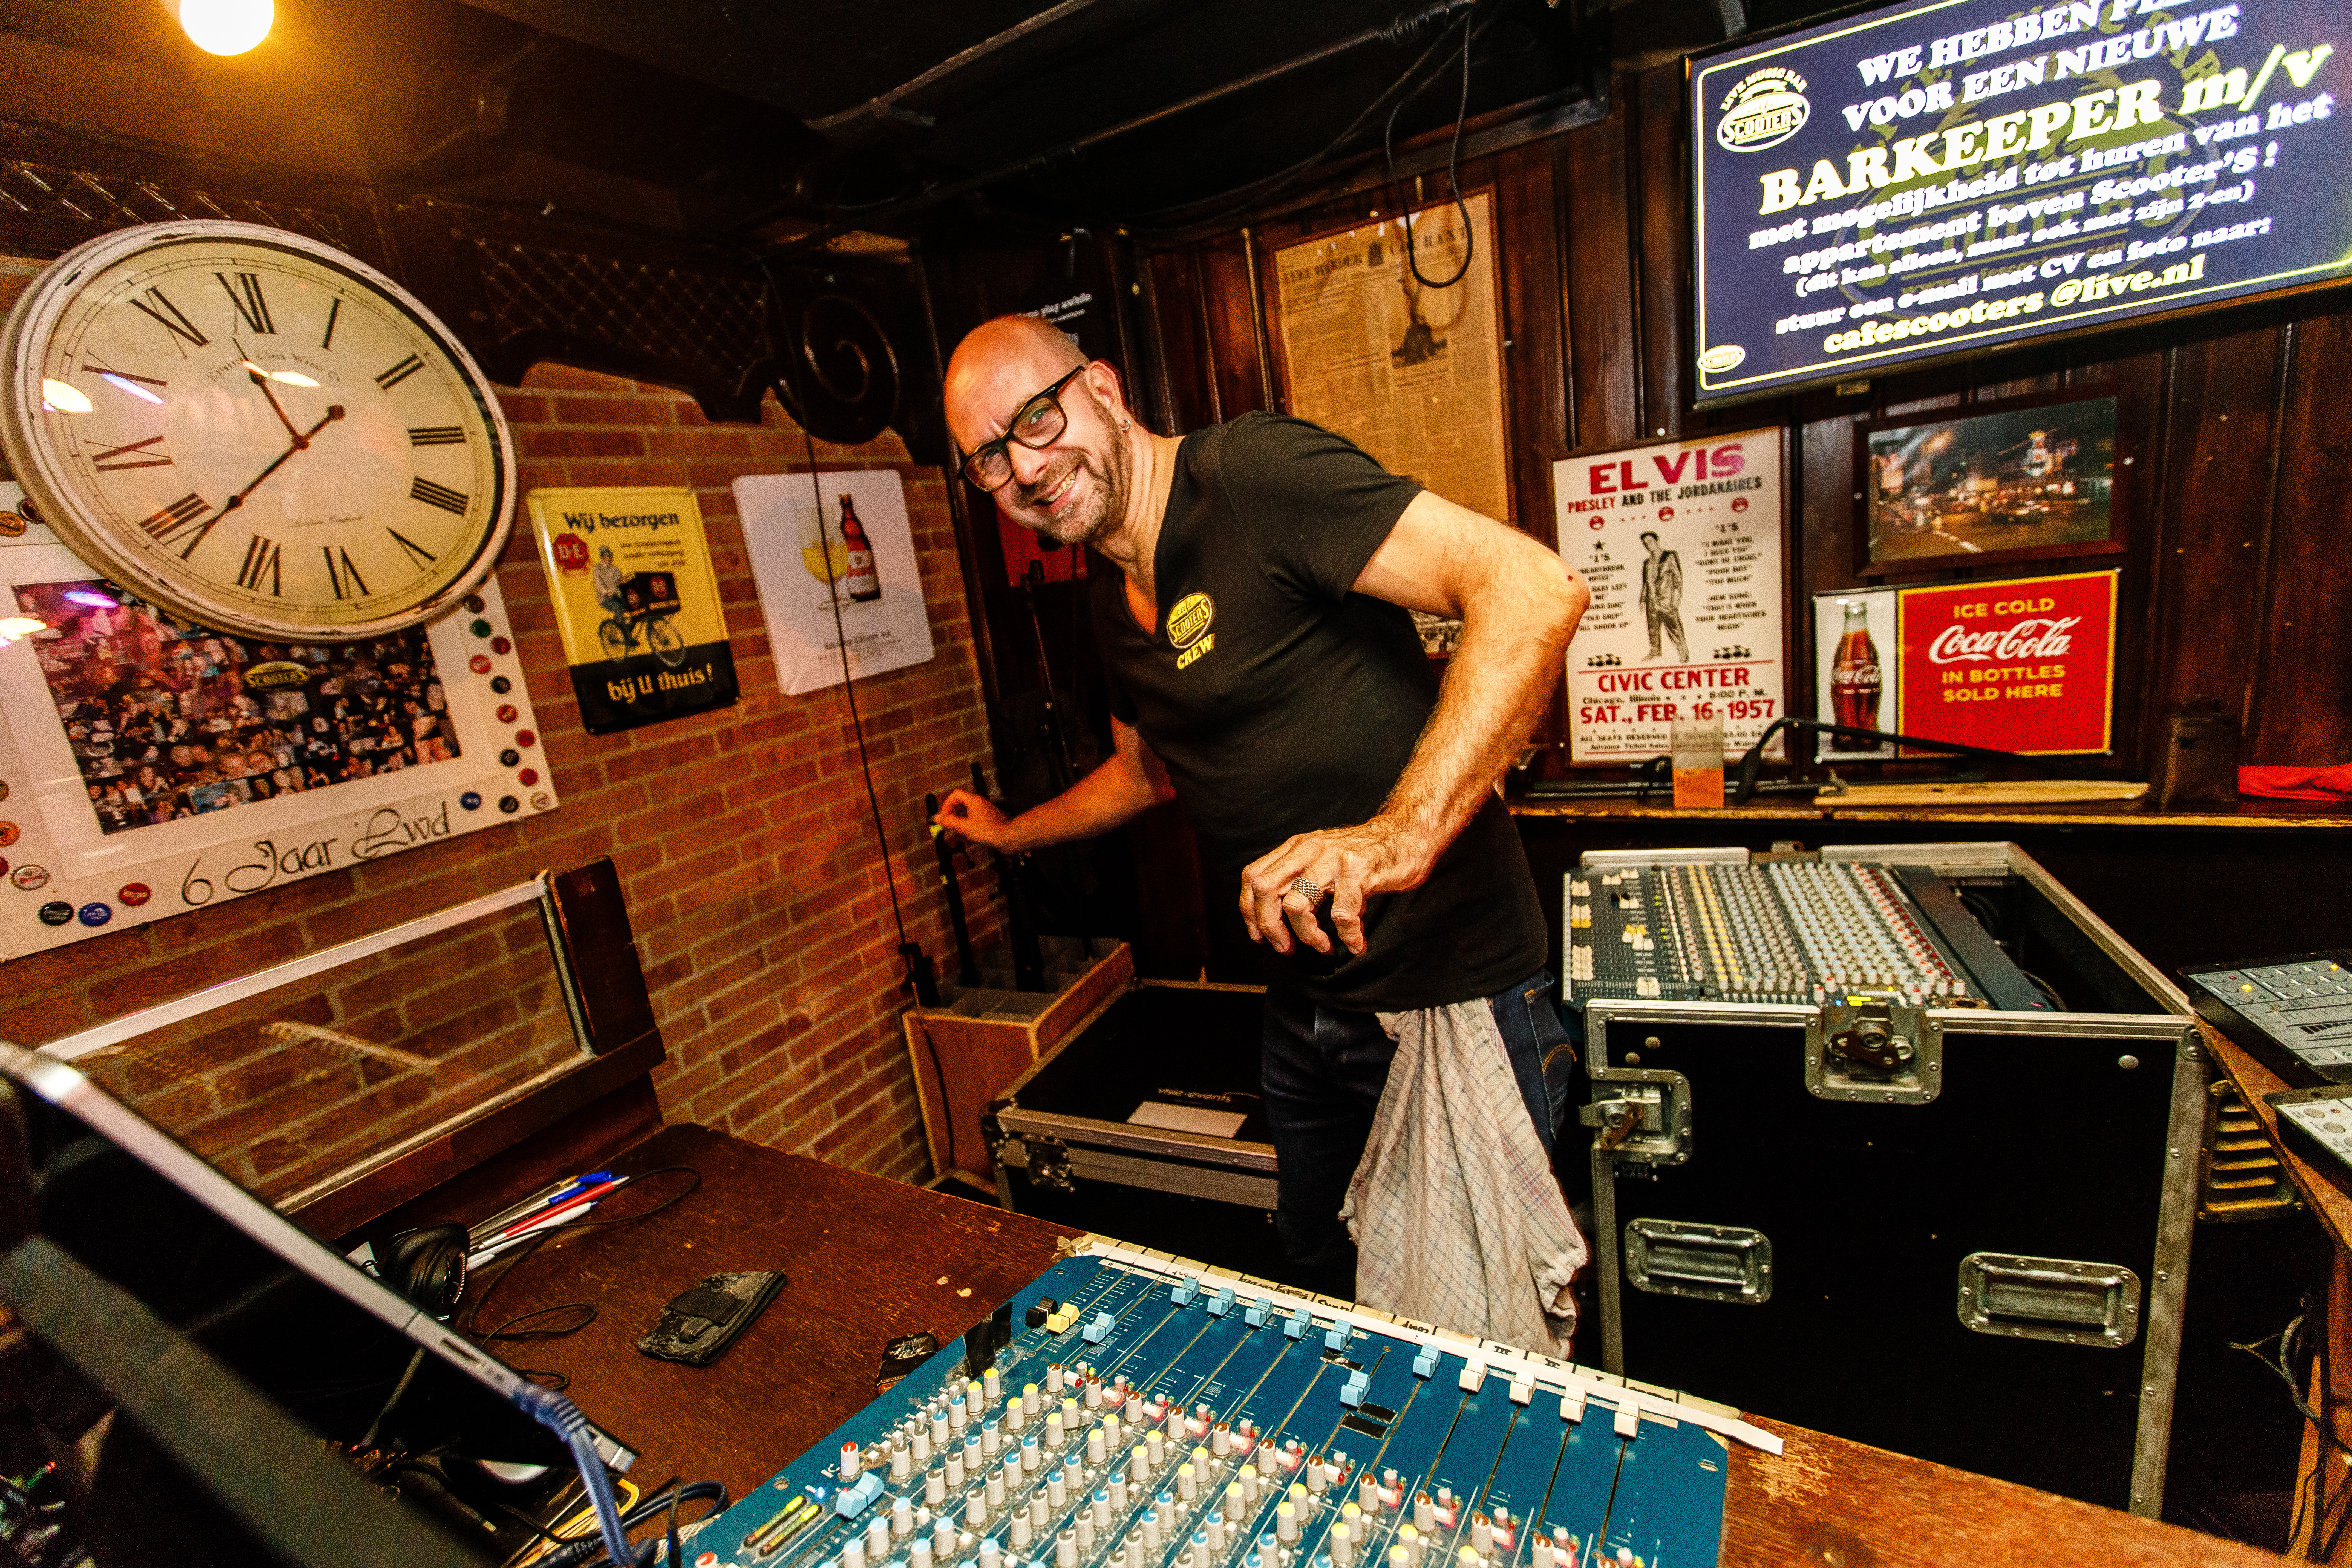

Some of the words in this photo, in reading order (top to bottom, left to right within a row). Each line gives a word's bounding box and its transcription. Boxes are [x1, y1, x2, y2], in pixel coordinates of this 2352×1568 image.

[1857, 44, 1923, 86] WE
[1929, 0, 2102, 69] HEBBEN
[1842, 81, 1955, 131] VOOR
[1961, 55, 2049, 104] EEN
[2054, 3, 2241, 80] NIEUWE
[1720, 81, 1746, 111] LIVE
[1745, 67, 1786, 86] MUSIC
[1723, 101, 1803, 143] SCOOTERS
[1759, 79, 2164, 215] BARKEEPER
[2177, 44, 2334, 115] m/v
[1749, 217, 1807, 250] met
[1812, 168, 2018, 235] mogelijkheid
[2024, 154, 2076, 185] tot
[2079, 132, 2186, 173] huren
[2194, 114, 2260, 145] van
[2265, 90, 2335, 130] het
[1783, 211, 1982, 273] appartement
[1988, 191, 2085, 227] boven
[1796, 272, 1839, 297] (dit
[1841, 263, 1886, 285] kan
[1888, 248, 1963, 274] alleen,
[1967, 230, 2029, 257] maar
[2032, 219, 2080, 243] ook
[2082, 206, 2134, 233] met
[2135, 196, 2185, 220] zijn
[1776, 306, 1846, 334] stuur
[1849, 297, 1894, 319] een
[1897, 275, 1979, 308] e-mail
[1981, 264, 2036, 292] met
[2040, 251, 2085, 278] CV
[2087, 248, 2123, 269] en
[2126, 235, 2188, 262] foto
[2191, 217, 2272, 248] naar:
[1823, 292, 2043, 353] cafescooters
[2050, 254, 2206, 307] @live.nl
[1589, 444, 1745, 495] ELVIS
[1568, 496, 1615, 513] PRESLEY
[1621, 493, 1644, 507] AND
[1650, 488, 1672, 502] THE
[1678, 476, 1762, 500] JORDANAIRES
[562, 512, 594, 533] Wij
[599, 512, 679, 530] bezorgen
[1169, 599, 1209, 642] SCOOTERS
[1953, 603, 1988, 619] ICE
[1995, 597, 2055, 616] COLD
[1177, 634, 1214, 669] CREW
[607, 680, 635, 704] bij
[638, 674, 653, 695] U
[657, 663, 714, 691] thuis!
[1598, 672, 1653, 692] CIVIC
[1661, 667, 1750, 690] CENTER
[1942, 671, 1963, 685] IN
[1969, 664, 2066, 684] BOTTLES
[1943, 687, 1999, 703] SOLD
[2006, 683, 2063, 699] HERE
[1629, 694, 1661, 702] Illinois
[1637, 703, 1684, 722] FEB.
[182, 857, 214, 905] 6
